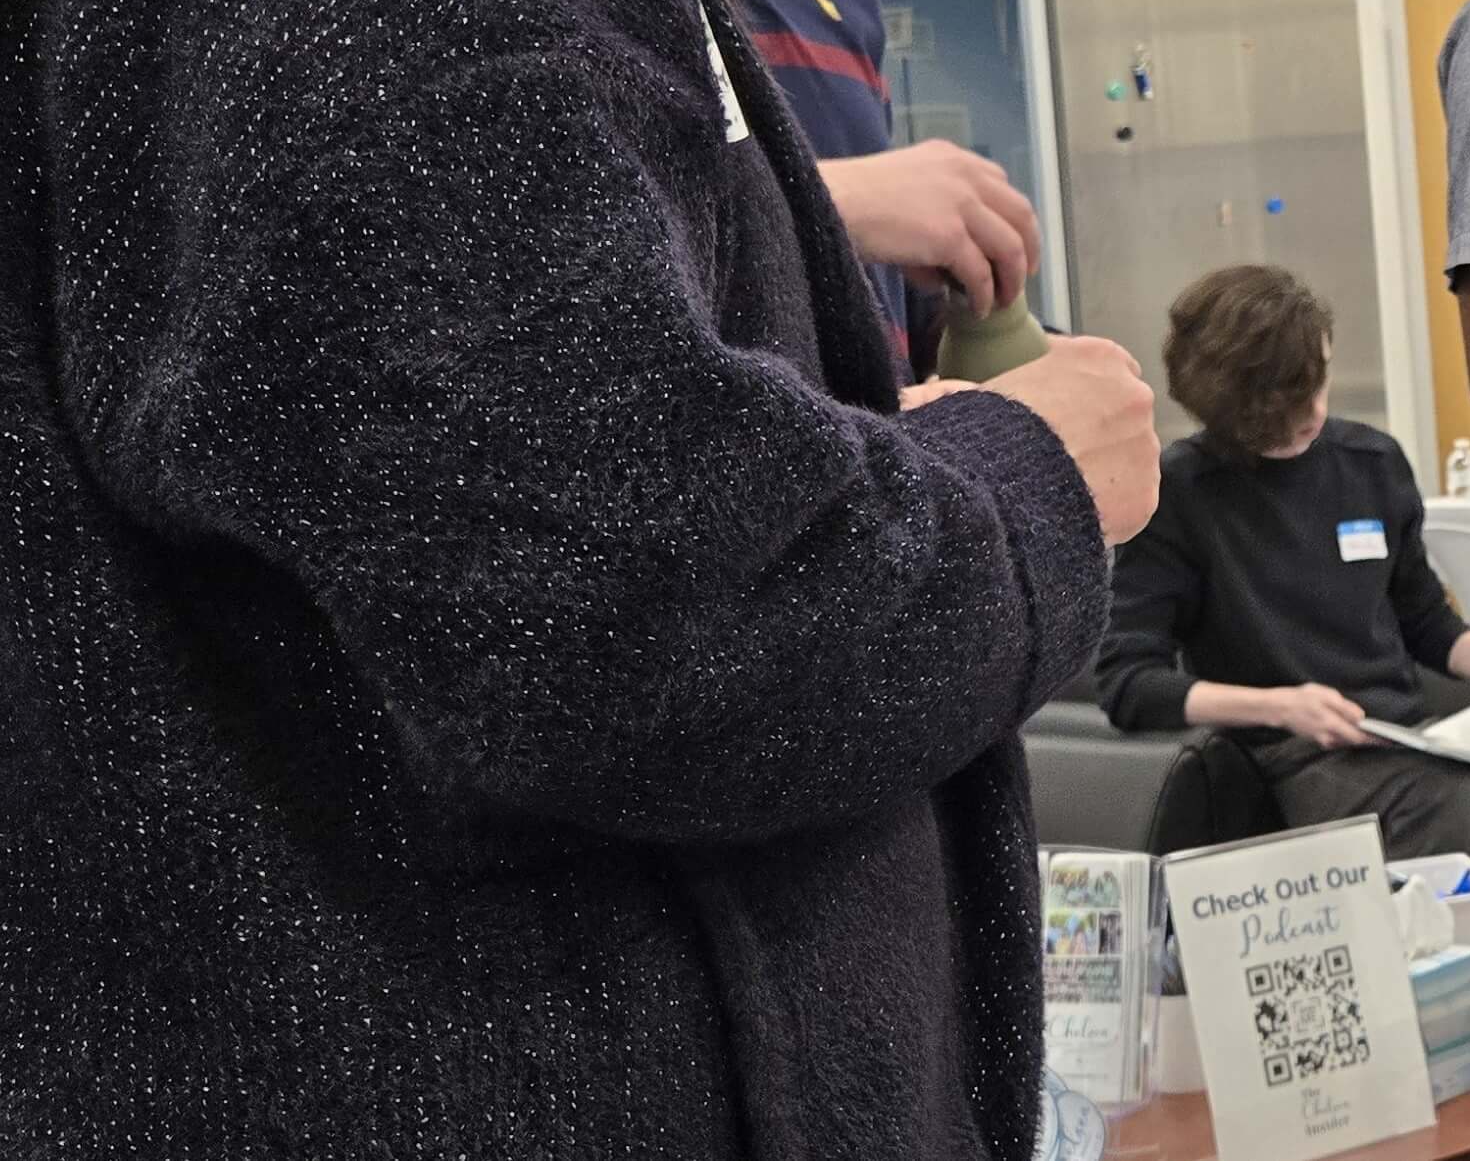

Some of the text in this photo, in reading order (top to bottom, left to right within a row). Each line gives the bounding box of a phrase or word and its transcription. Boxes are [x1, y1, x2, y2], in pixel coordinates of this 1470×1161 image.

[1192, 866, 1369, 918] Check Out Our
[1240, 906, 1340, 959] Podcast
